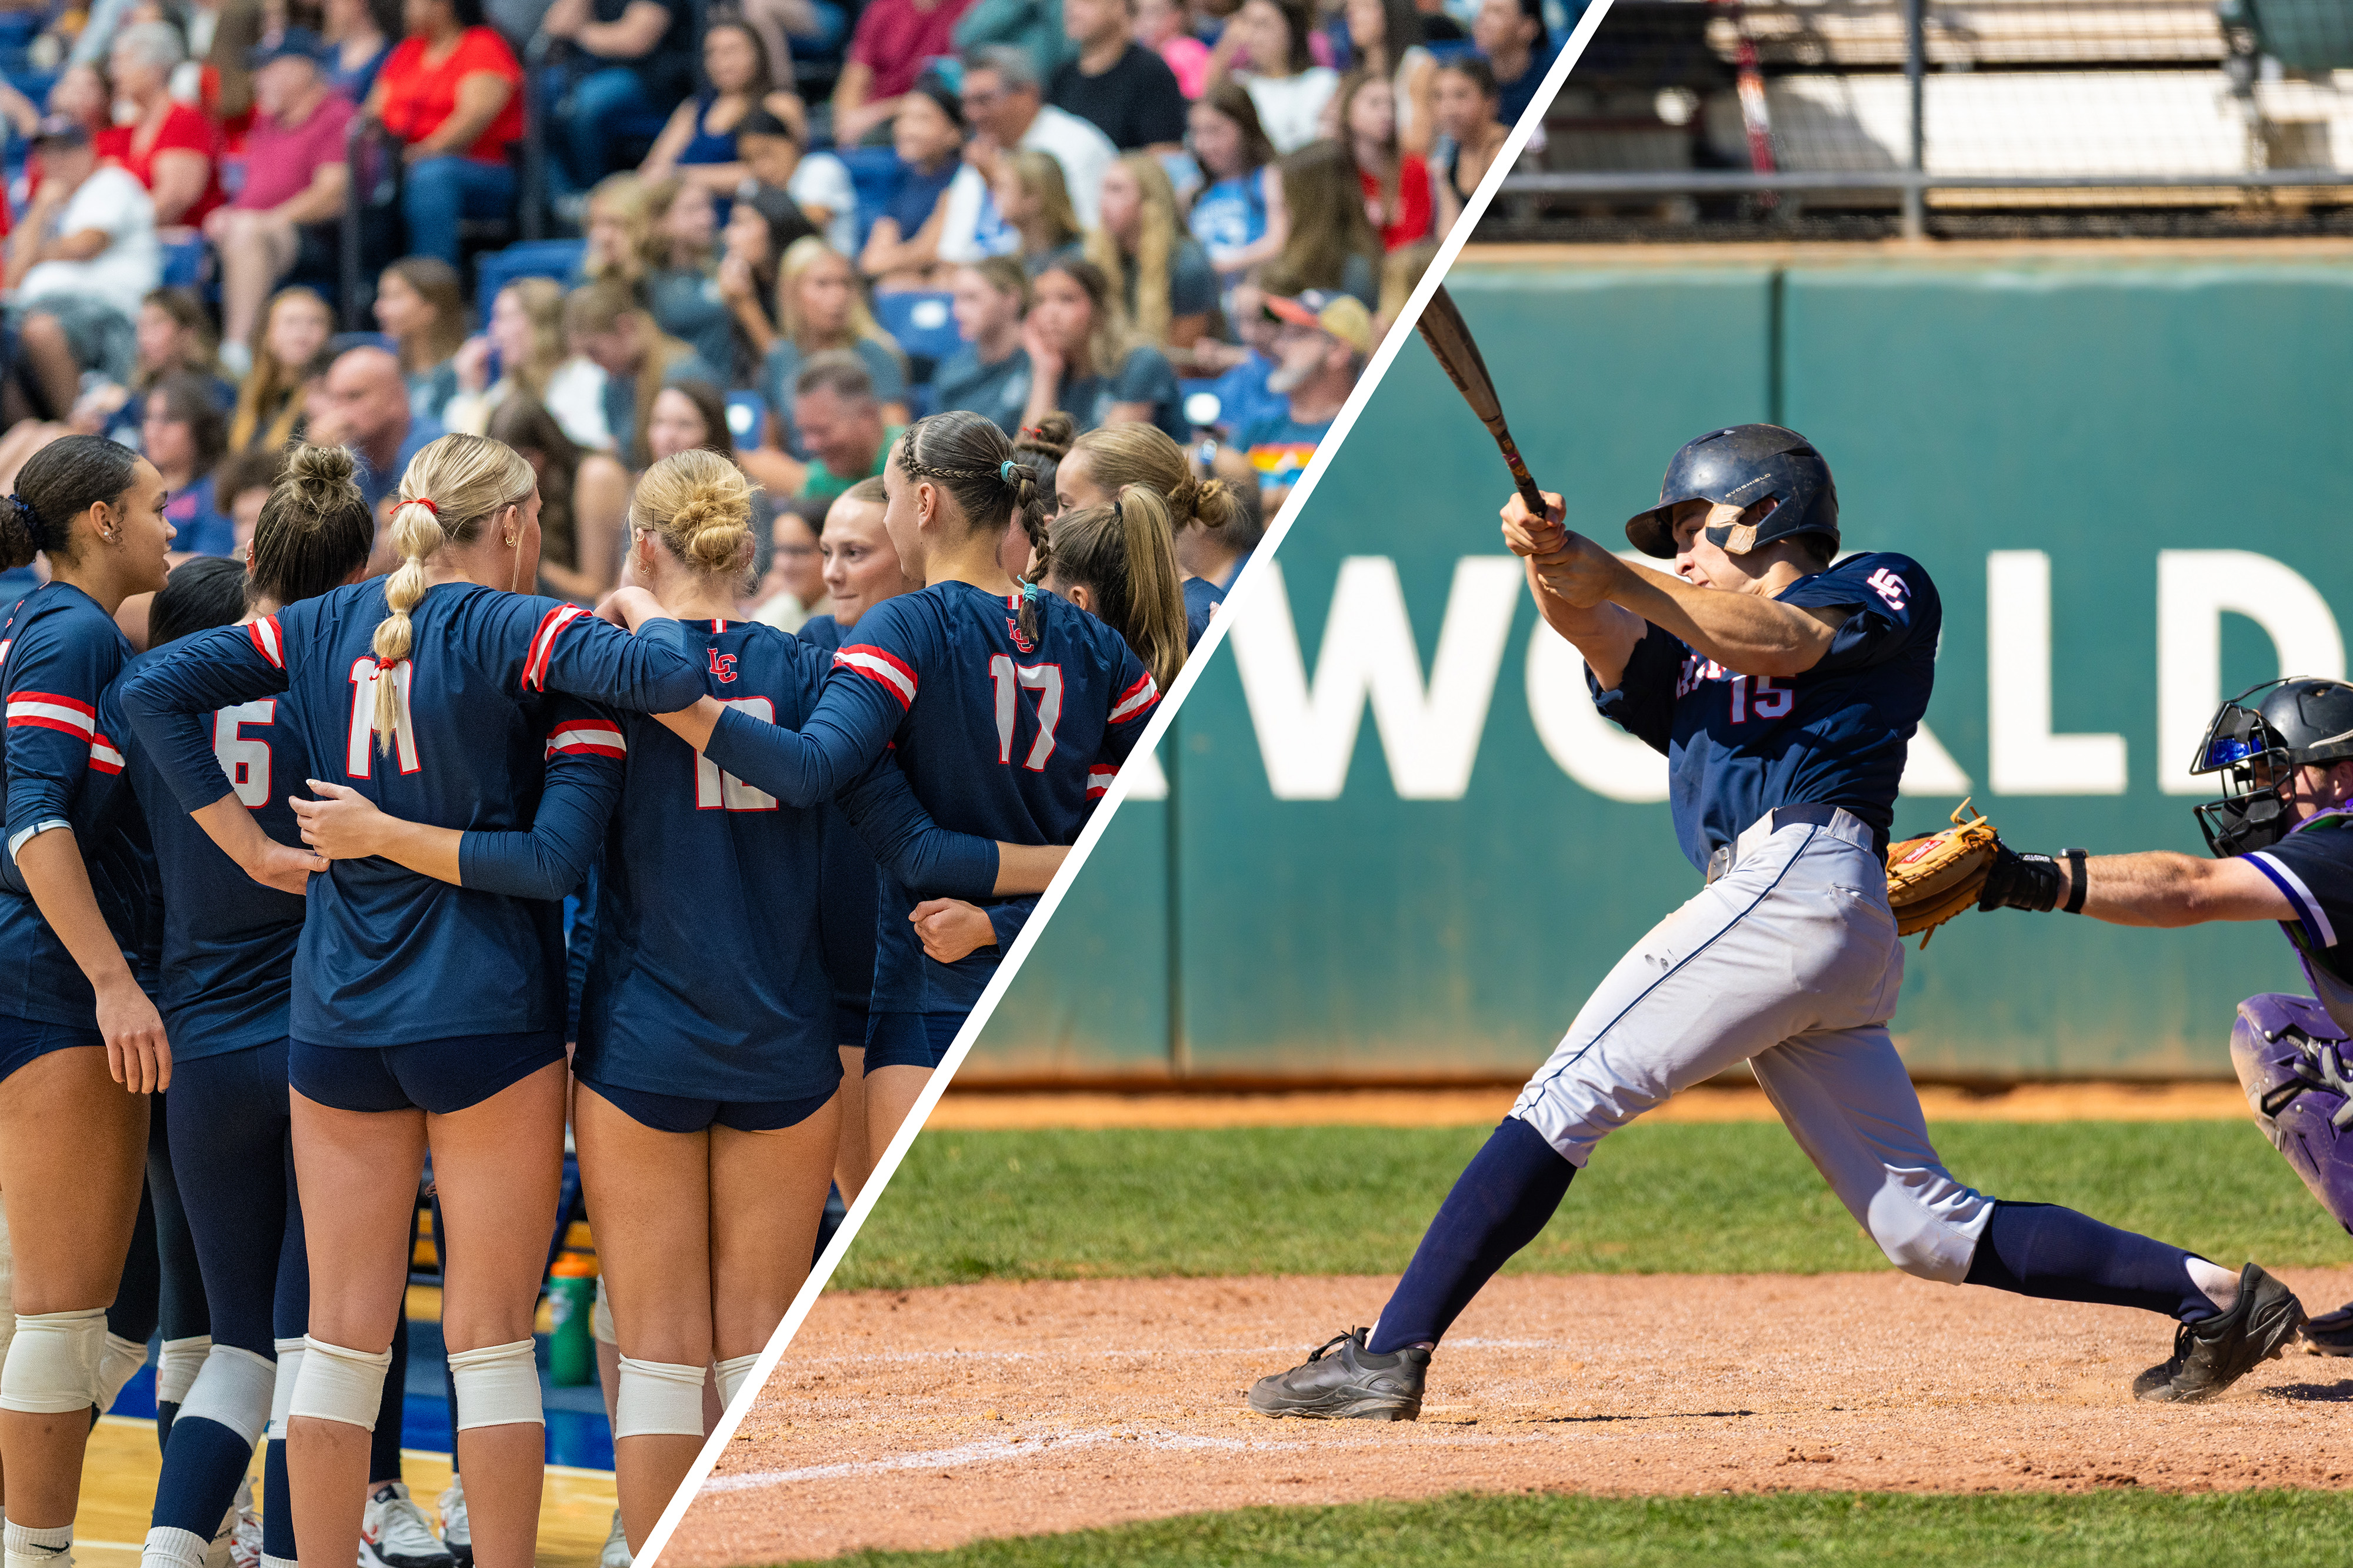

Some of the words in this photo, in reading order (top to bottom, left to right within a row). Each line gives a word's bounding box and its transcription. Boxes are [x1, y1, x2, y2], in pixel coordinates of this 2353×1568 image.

[1867, 568, 1911, 610] LC
[346, 656, 422, 779] 11
[707, 648, 737, 683] LC
[989, 652, 1064, 772] 17
[1231, 549, 2347, 803] WLD
[1729, 673, 1798, 725] 15
[212, 698, 277, 809] 6
